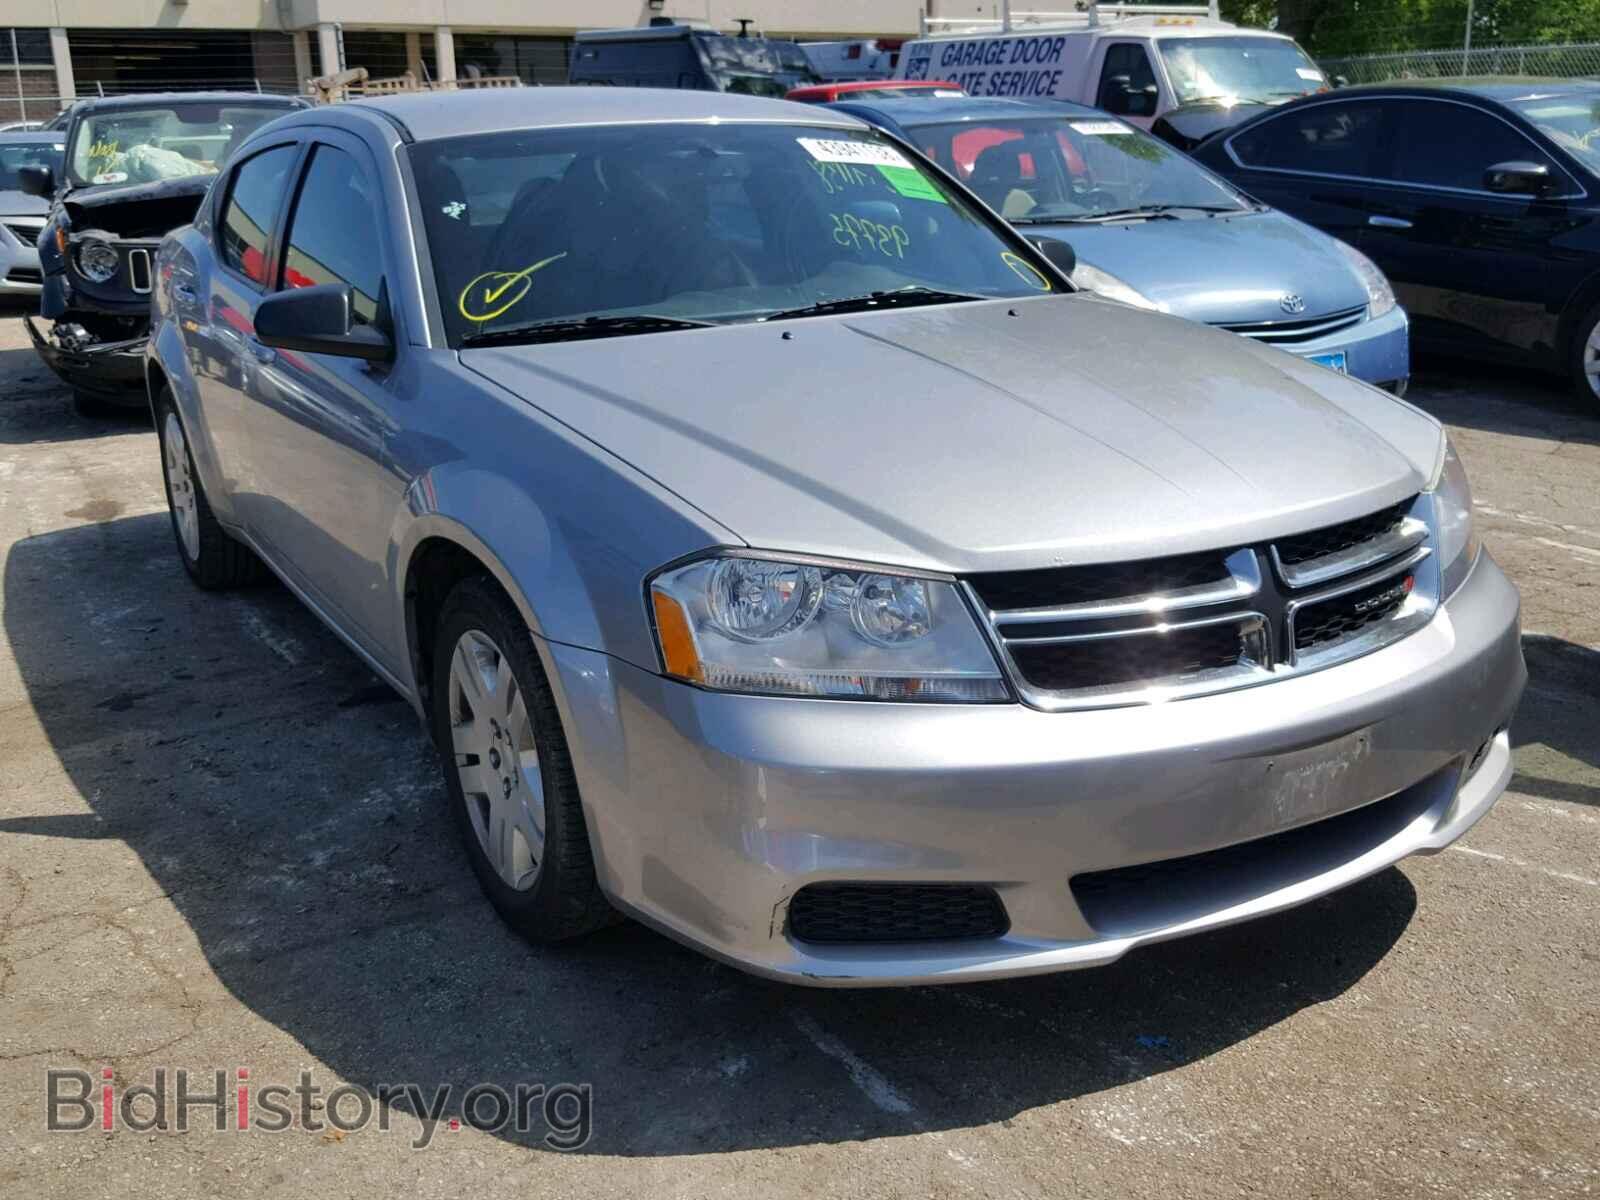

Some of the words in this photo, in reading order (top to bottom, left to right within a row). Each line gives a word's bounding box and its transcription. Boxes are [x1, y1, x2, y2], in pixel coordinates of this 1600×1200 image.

[941, 41, 1011, 67] GARAGE
[1009, 37, 1066, 64] DOOR
[986, 70, 1063, 97] SERVICE
